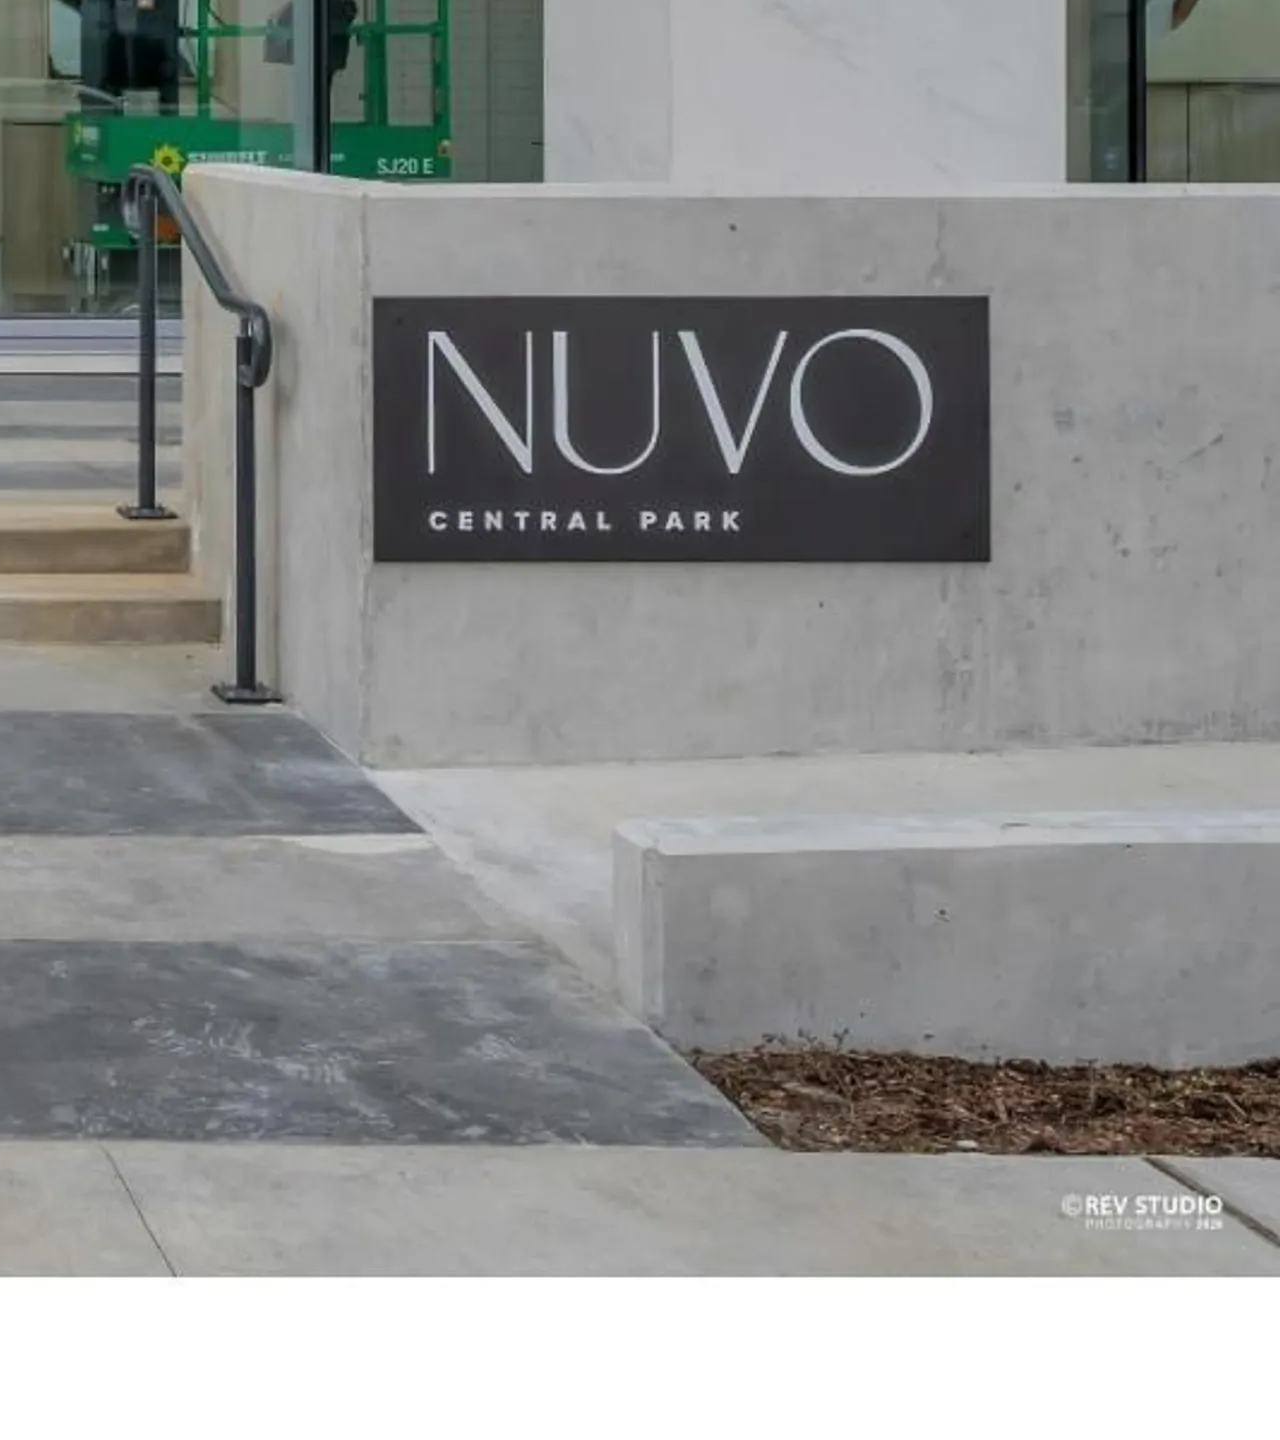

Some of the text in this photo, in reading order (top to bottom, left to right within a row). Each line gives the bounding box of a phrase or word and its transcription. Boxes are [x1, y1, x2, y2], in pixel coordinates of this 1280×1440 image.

[376, 157, 434, 174] SJ20 E
[427, 328, 934, 477] NUVO
[427, 510, 743, 532] CENTRAL PARK
